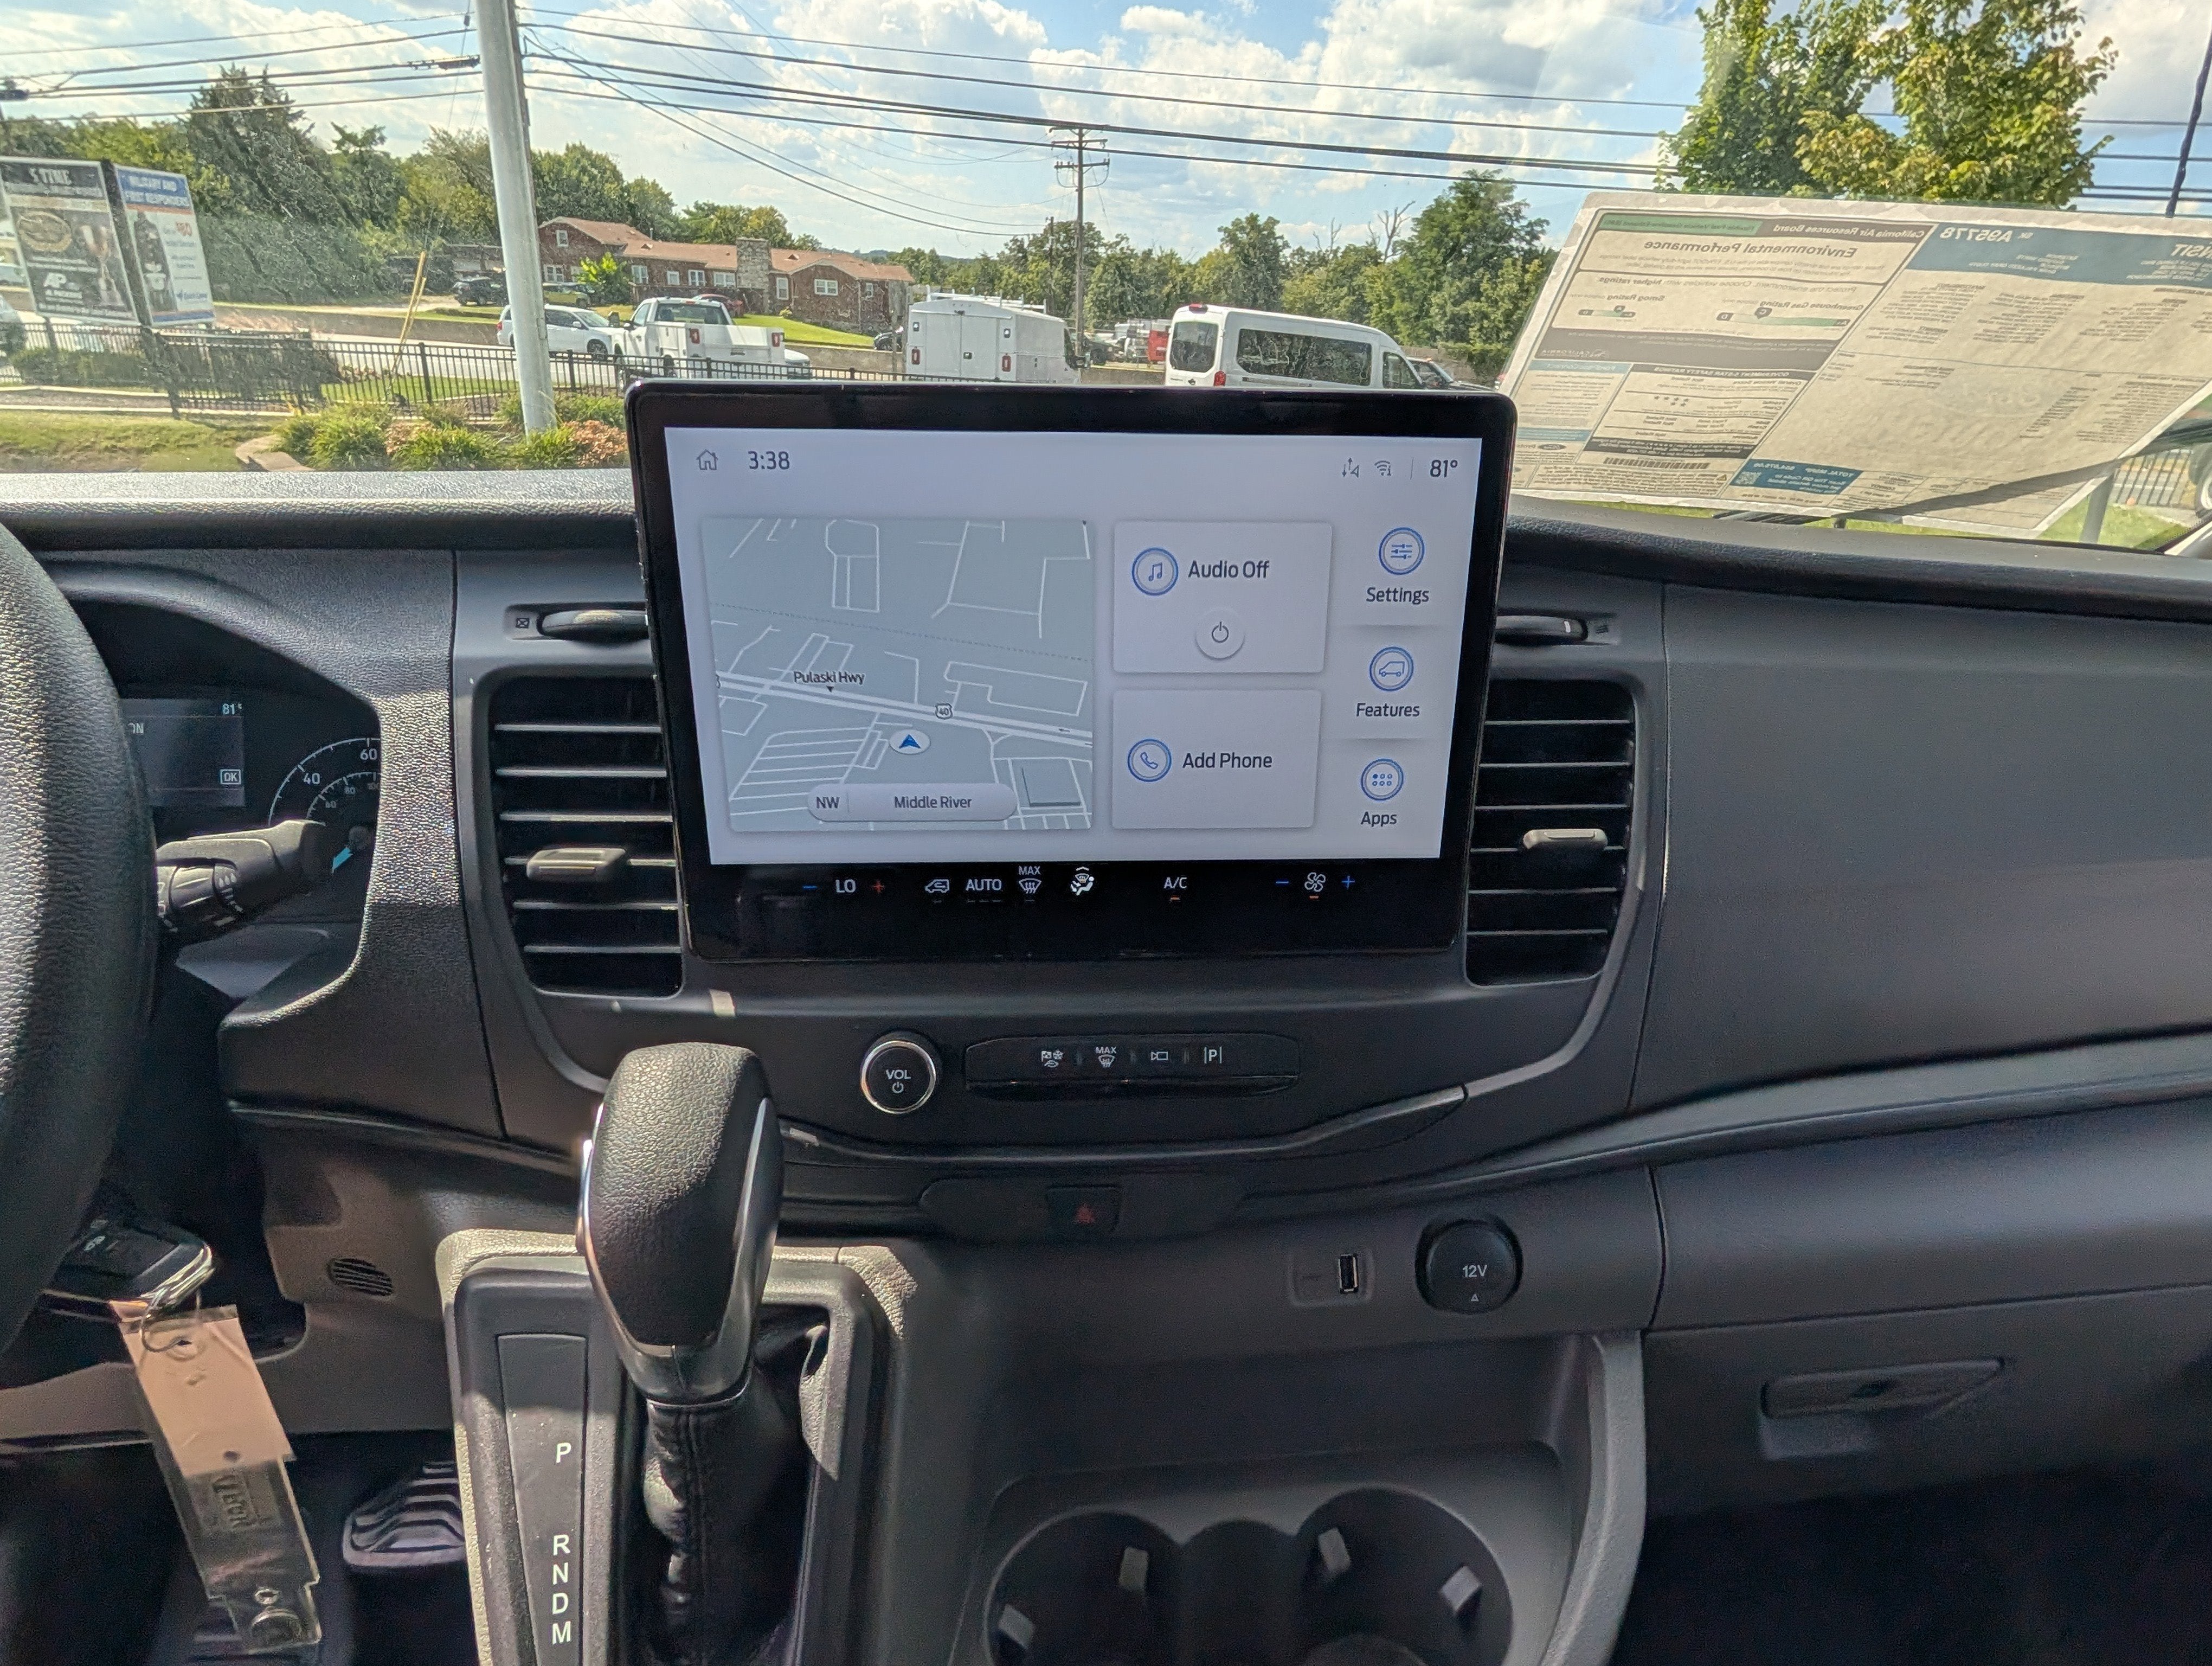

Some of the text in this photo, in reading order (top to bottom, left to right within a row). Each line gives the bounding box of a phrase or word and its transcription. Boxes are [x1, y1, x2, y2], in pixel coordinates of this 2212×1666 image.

[748, 451, 790, 470] 3:38
[1430, 459, 1458, 478] 81°
[1188, 560, 1269, 578] Audio Off
[1366, 587, 1429, 605] Settings
[793, 671, 865, 685] Pulaski Hwy
[939, 707, 949, 716] 40
[1356, 703, 1420, 717] Features
[360, 748, 377, 760] 60
[1182, 752, 1272, 768] Add Phone
[223, 772, 238, 783] OK
[303, 772, 320, 785] 40
[816, 796, 972, 809] NW Middle River
[1360, 811, 1397, 827] Apps
[1018, 866, 1041, 875] MAX
[835, 879, 857, 894] LO
[966, 878, 1002, 891] AUTO
[1163, 877, 1187, 889] A/C
[1096, 1046, 1117, 1054] MAX
[885, 1069, 911, 1080] VOL
[1462, 1264, 1487, 1278] 12V
[555, 1441, 571, 1463] P
[553, 1534, 570, 1556] R
[552, 1561, 569, 1585] N
[552, 1592, 569, 1615] D
[552, 1620, 571, 1645] M
